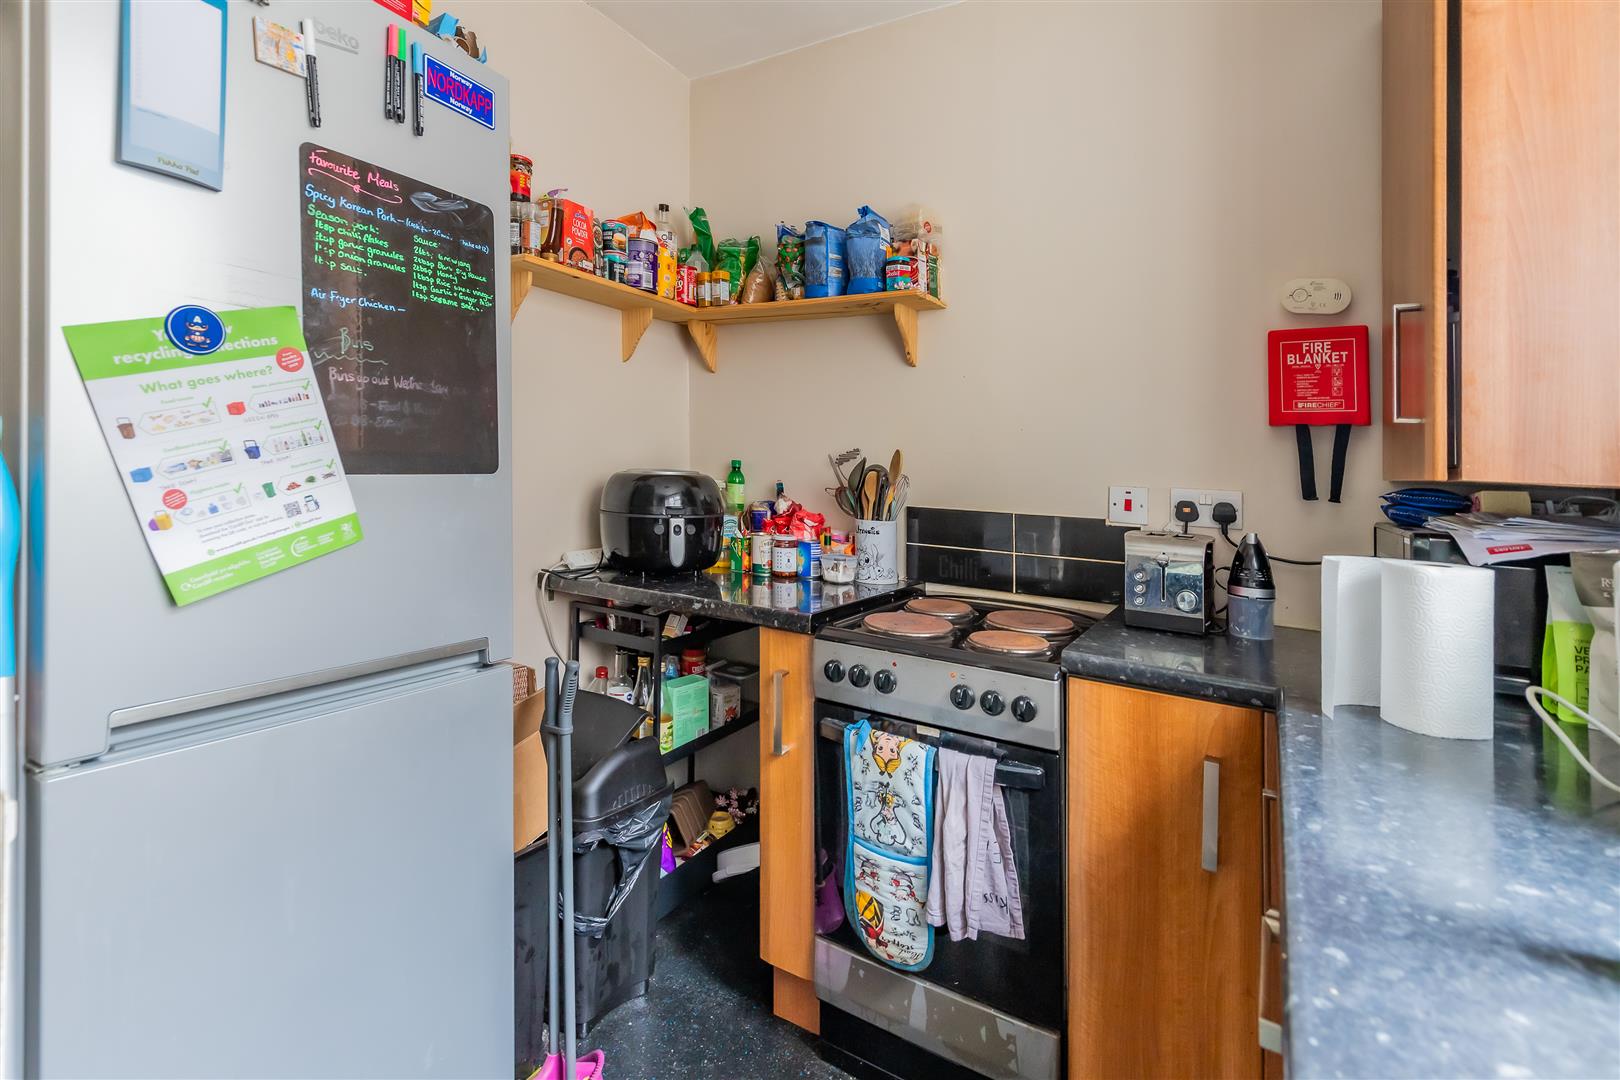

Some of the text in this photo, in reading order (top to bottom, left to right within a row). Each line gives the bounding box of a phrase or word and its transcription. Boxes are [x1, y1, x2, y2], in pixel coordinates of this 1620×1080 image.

[449, 71, 473, 89] Norway
[427, 67, 493, 116] NORDKAPP
[449, 97, 473, 115] Norway
[309, 150, 399, 191] Favourite Meals
[305, 183, 336, 208] Spicy
[339, 196, 374, 216] Korean
[307, 203, 348, 226] Season
[571, 226, 588, 239] POWDER
[573, 218, 587, 230] COCOA
[367, 246, 405, 261] granules
[367, 258, 406, 273] granules
[310, 287, 327, 299] Air
[329, 290, 357, 308] Fryer
[1302, 341, 1332, 354] FIRE
[1287, 352, 1348, 365] BLANKET
[139, 366, 273, 395] What goes where?
[371, 373, 390, 385] out
